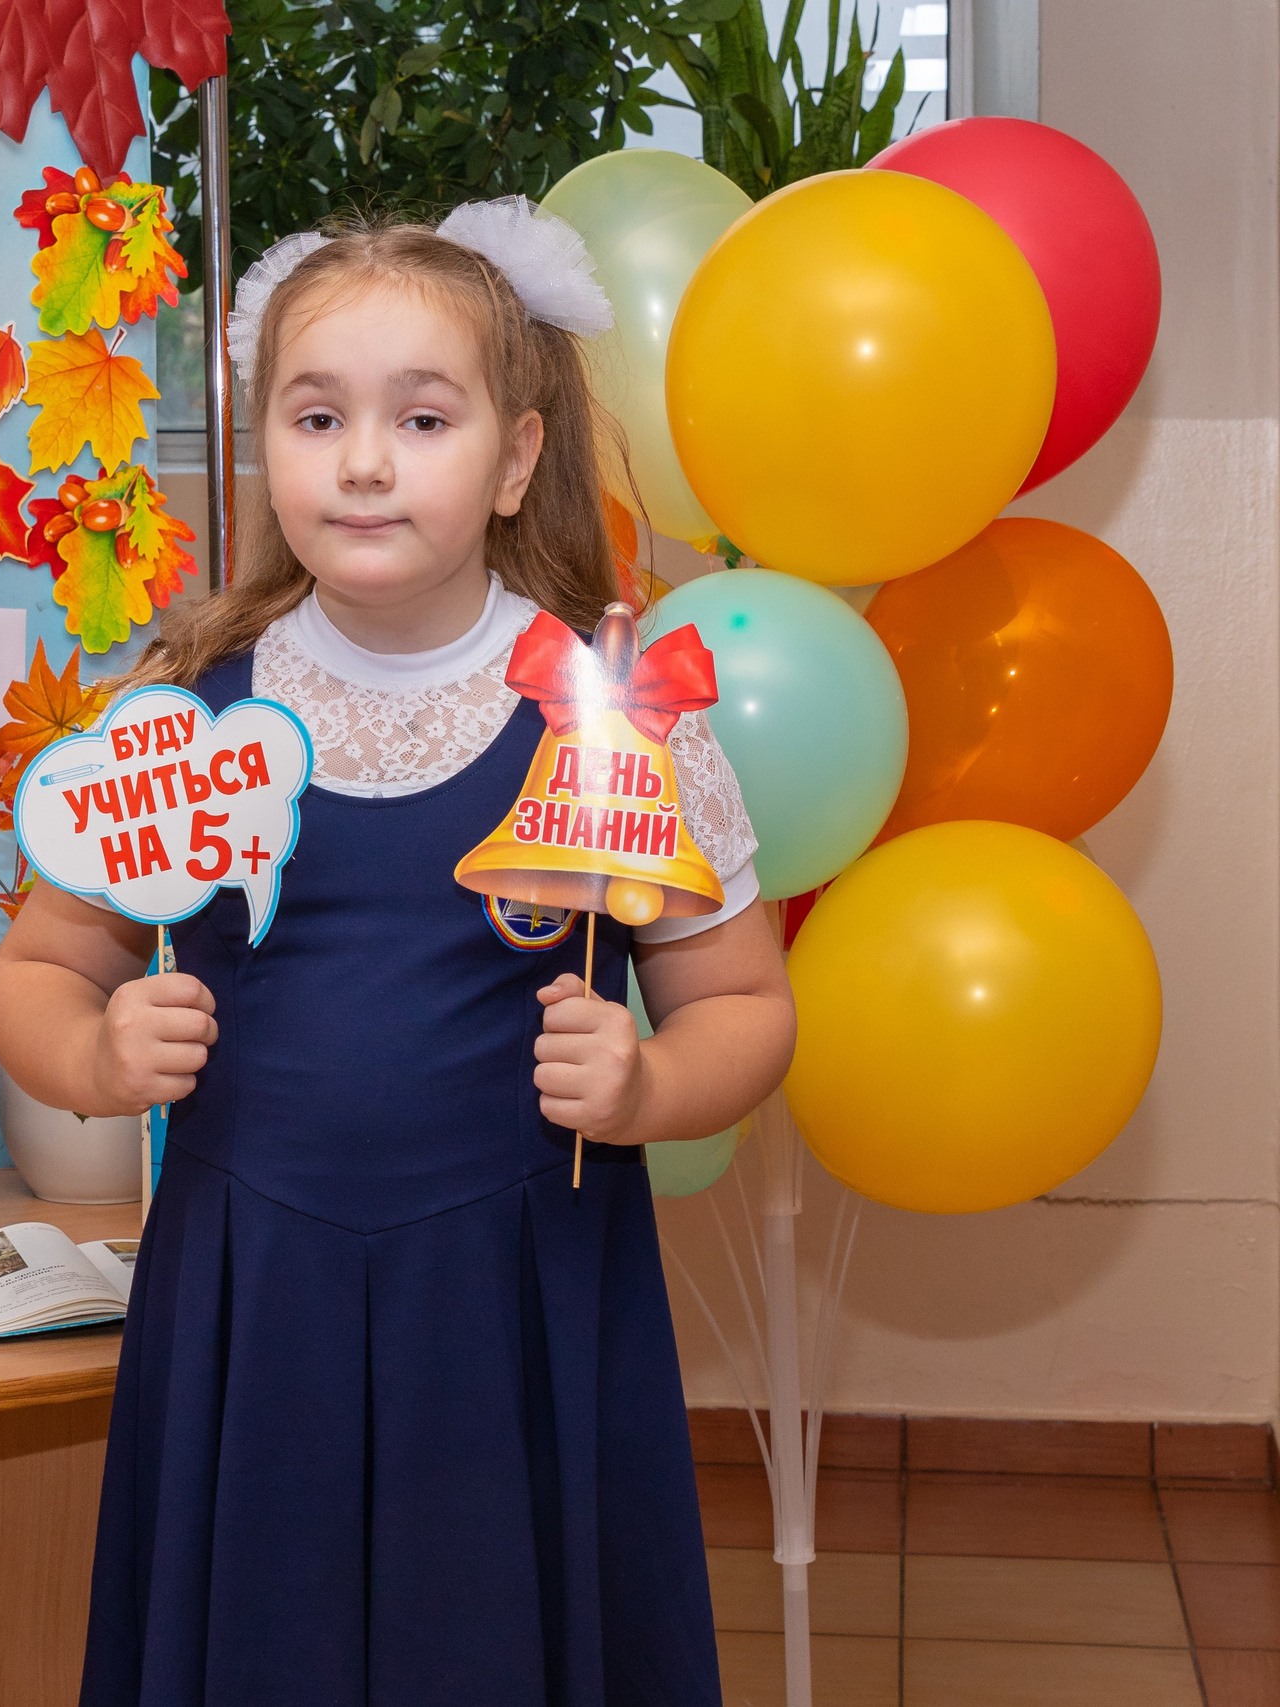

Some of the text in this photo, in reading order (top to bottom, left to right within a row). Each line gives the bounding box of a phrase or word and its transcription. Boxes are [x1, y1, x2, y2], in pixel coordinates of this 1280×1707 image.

[110, 709, 196, 762] БУДУ
[62, 741, 271, 834] УЧИТЬСЯ
[547, 744, 663, 799] ДЕНЬ
[99, 824, 172, 885] НА
[514, 798, 679, 859] ЗНАНИЙ
